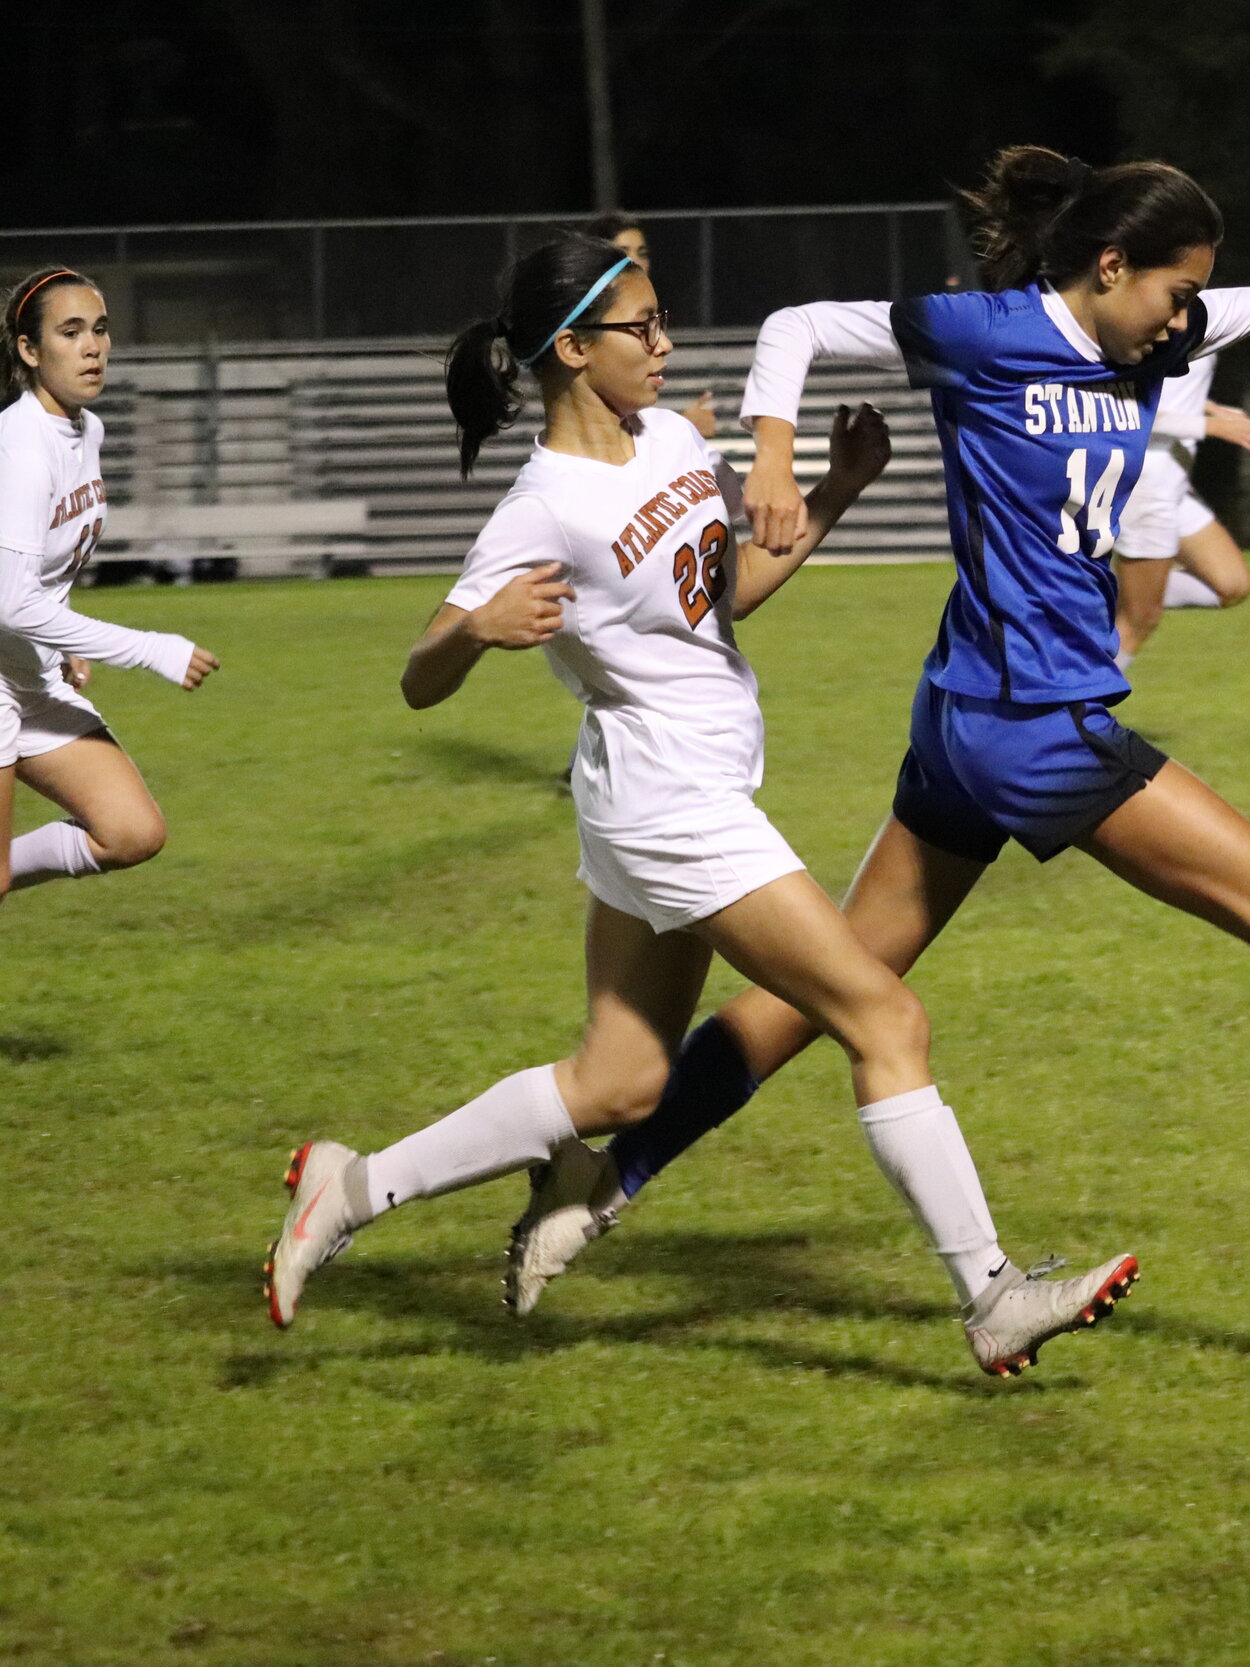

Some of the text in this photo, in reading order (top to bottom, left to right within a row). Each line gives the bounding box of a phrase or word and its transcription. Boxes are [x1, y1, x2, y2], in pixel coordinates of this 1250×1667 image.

[1025, 382, 1141, 436] STANTON
[611, 491, 689, 580] ATLANTIC
[1057, 448, 1126, 559] 14
[673, 518, 729, 632] 22
